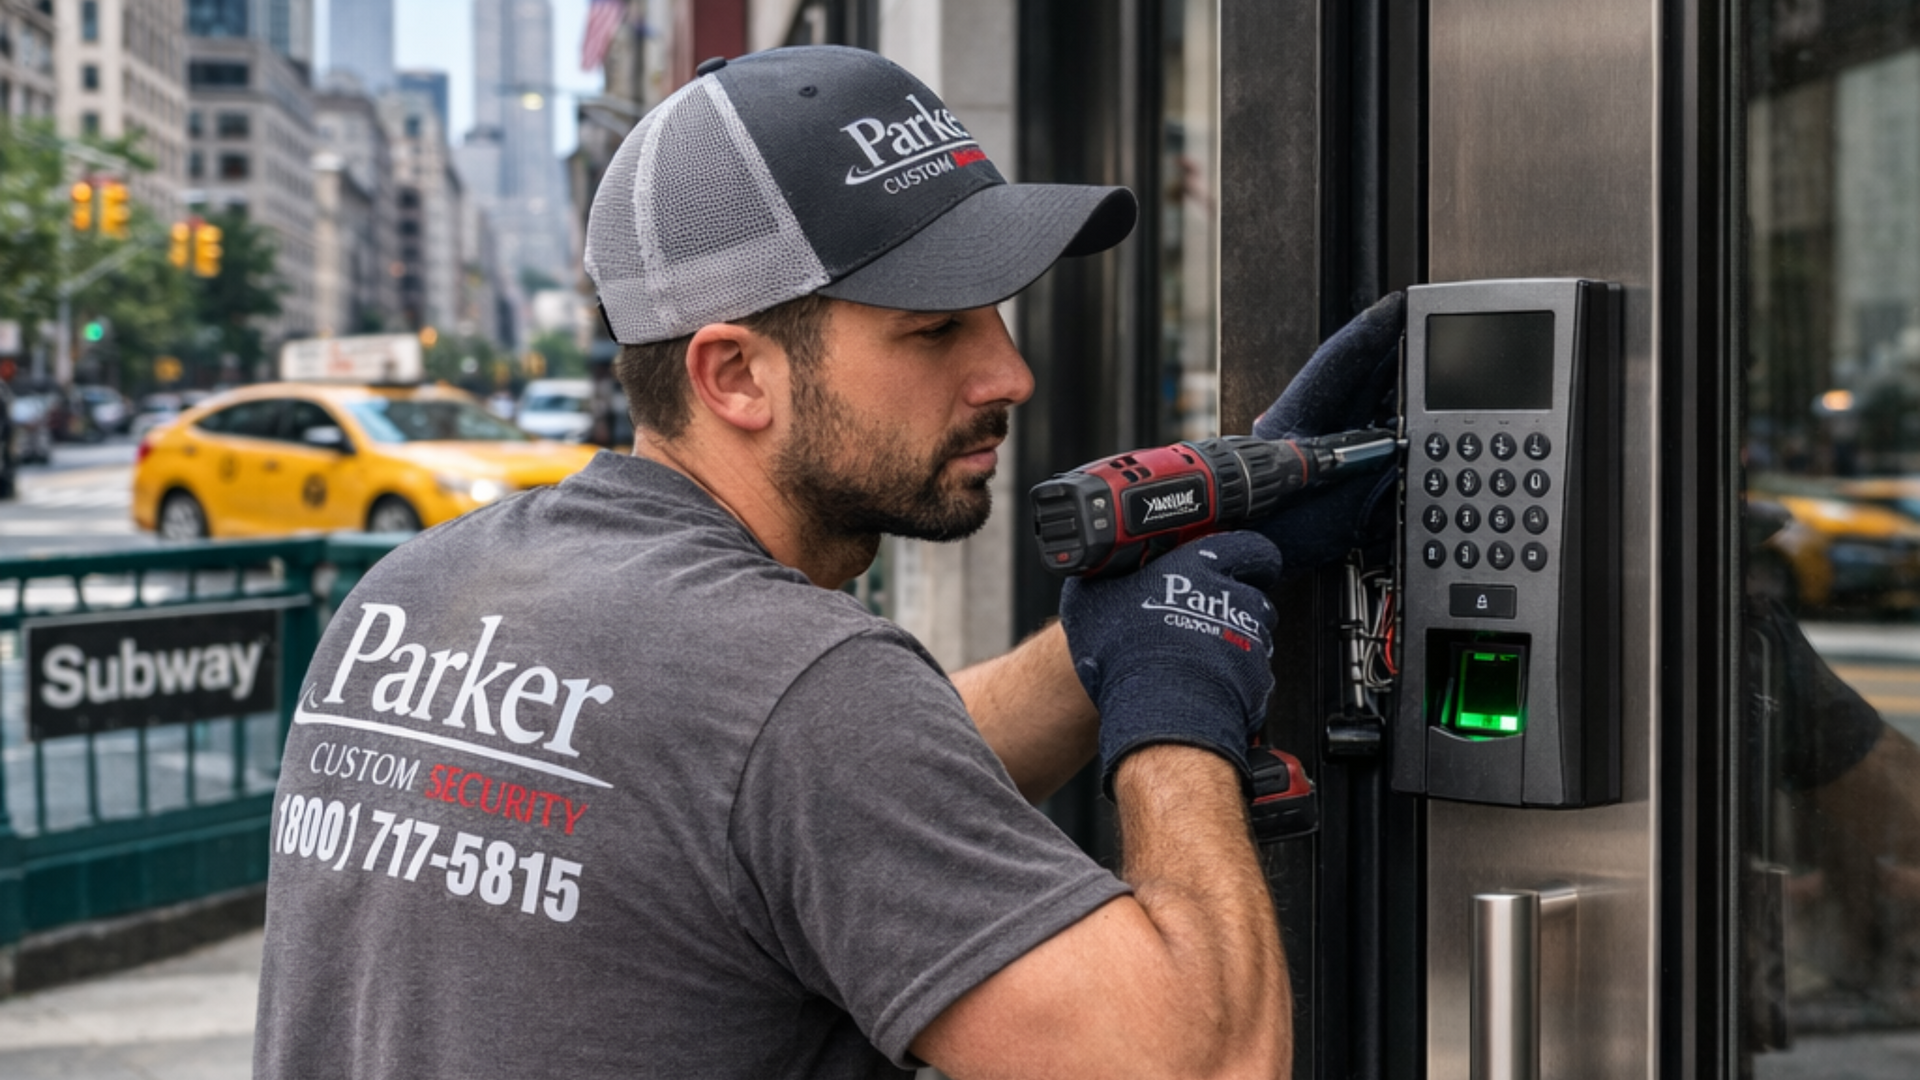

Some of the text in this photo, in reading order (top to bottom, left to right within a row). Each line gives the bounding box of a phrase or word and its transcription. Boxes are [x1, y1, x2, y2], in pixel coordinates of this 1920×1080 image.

[839, 93, 971, 168] Parke
[883, 153, 955, 195] CUSTOM
[41, 640, 261, 707] Subway
[323, 601, 614, 758] Parker
[309, 741, 589, 837] CUSTOM SECURITY
[362, 809, 584, 923] 717-5815
